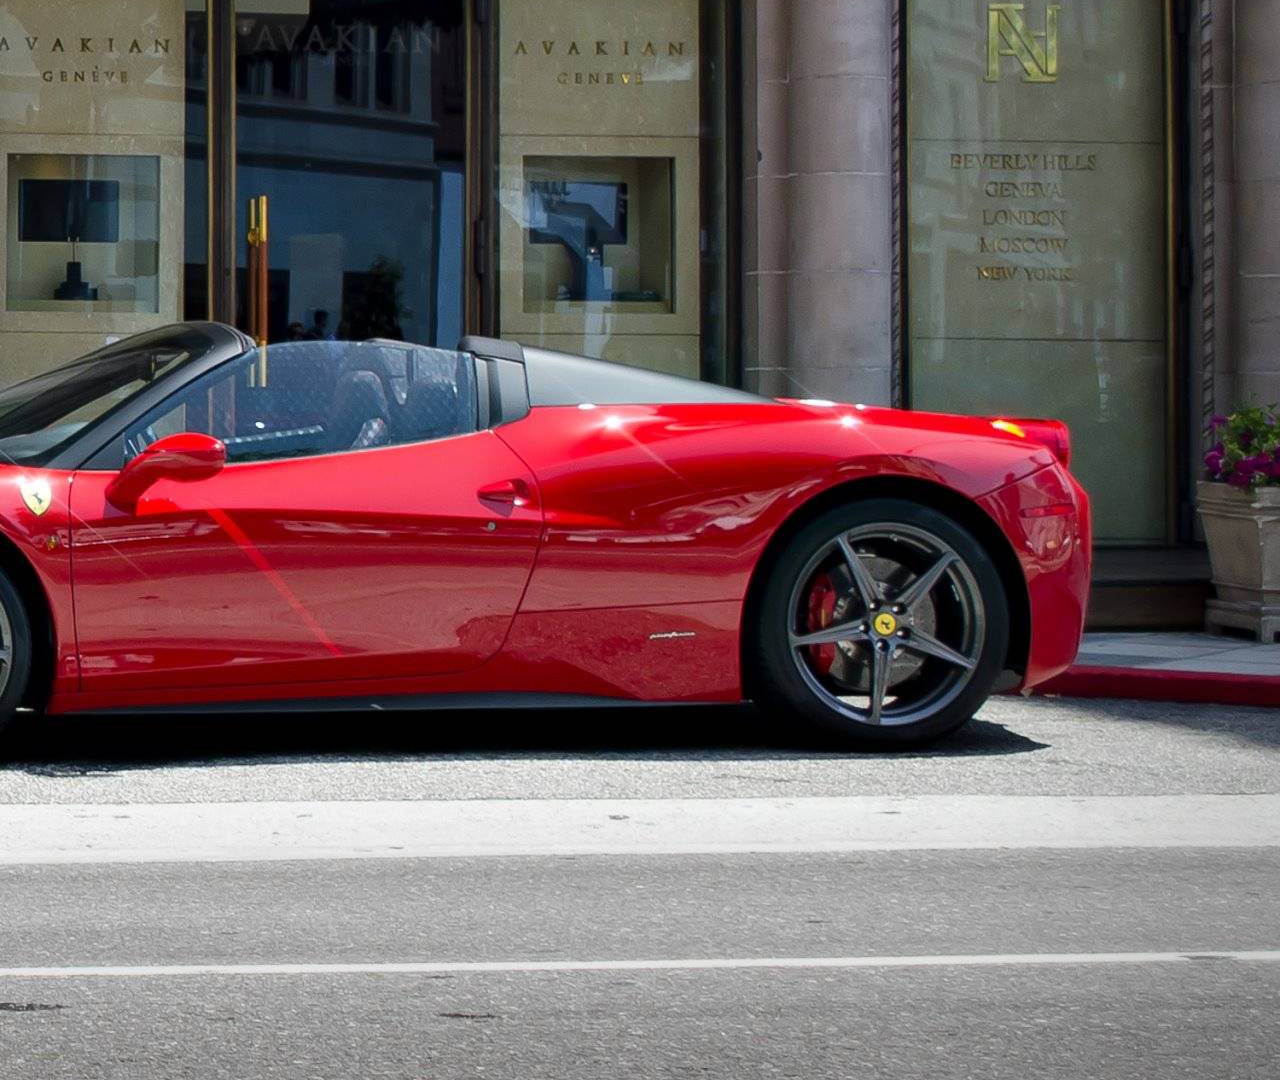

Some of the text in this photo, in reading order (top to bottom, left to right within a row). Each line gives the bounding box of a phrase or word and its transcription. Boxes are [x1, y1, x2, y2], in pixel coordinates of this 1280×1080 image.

[515, 40, 683, 55] AVAKIAN
[950, 153, 1097, 171] BEVERLY HILLS
[984, 181, 1063, 199] GENEVA
[982, 210, 1067, 227] LONDON
[979, 236, 1070, 254] MOSCOW
[976, 265, 1074, 282] NEW YORK
